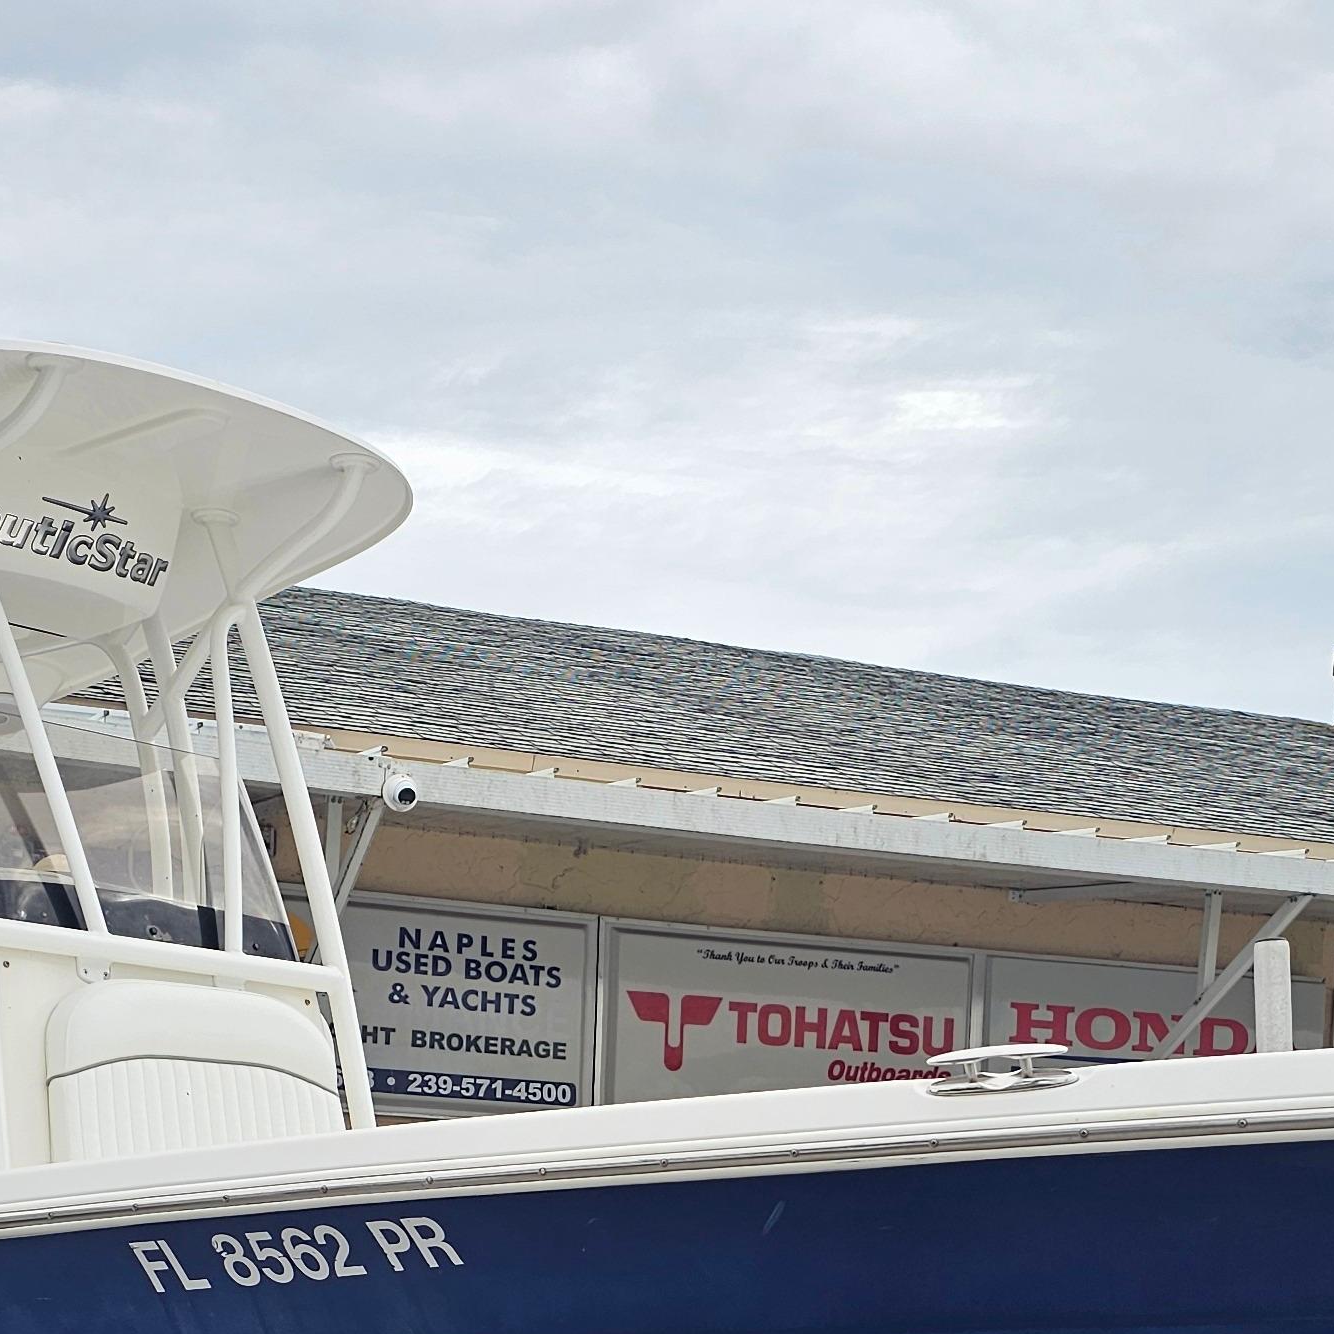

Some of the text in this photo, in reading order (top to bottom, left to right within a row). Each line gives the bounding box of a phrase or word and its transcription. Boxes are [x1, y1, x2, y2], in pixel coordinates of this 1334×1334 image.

[399, 927, 538, 961] NAPLES
[734, 951, 755, 965] You
[756, 954, 766, 964] to
[768, 955, 785, 965] Our
[787, 956, 818, 970] Troops
[821, 958, 829, 968] &
[831, 959, 855, 971] Their
[372, 949, 562, 988] USED BOATS
[388, 983, 537, 1016] & YACHTS
[411, 1029, 567, 1060] BROKERAGE
[728, 1001, 954, 1056] TOHATSU
[1009, 1001, 1257, 1056] HOND
[407, 1073, 571, 1103] 239-571-4500
[129, 1216, 464, 1293] FL 8562 PR
